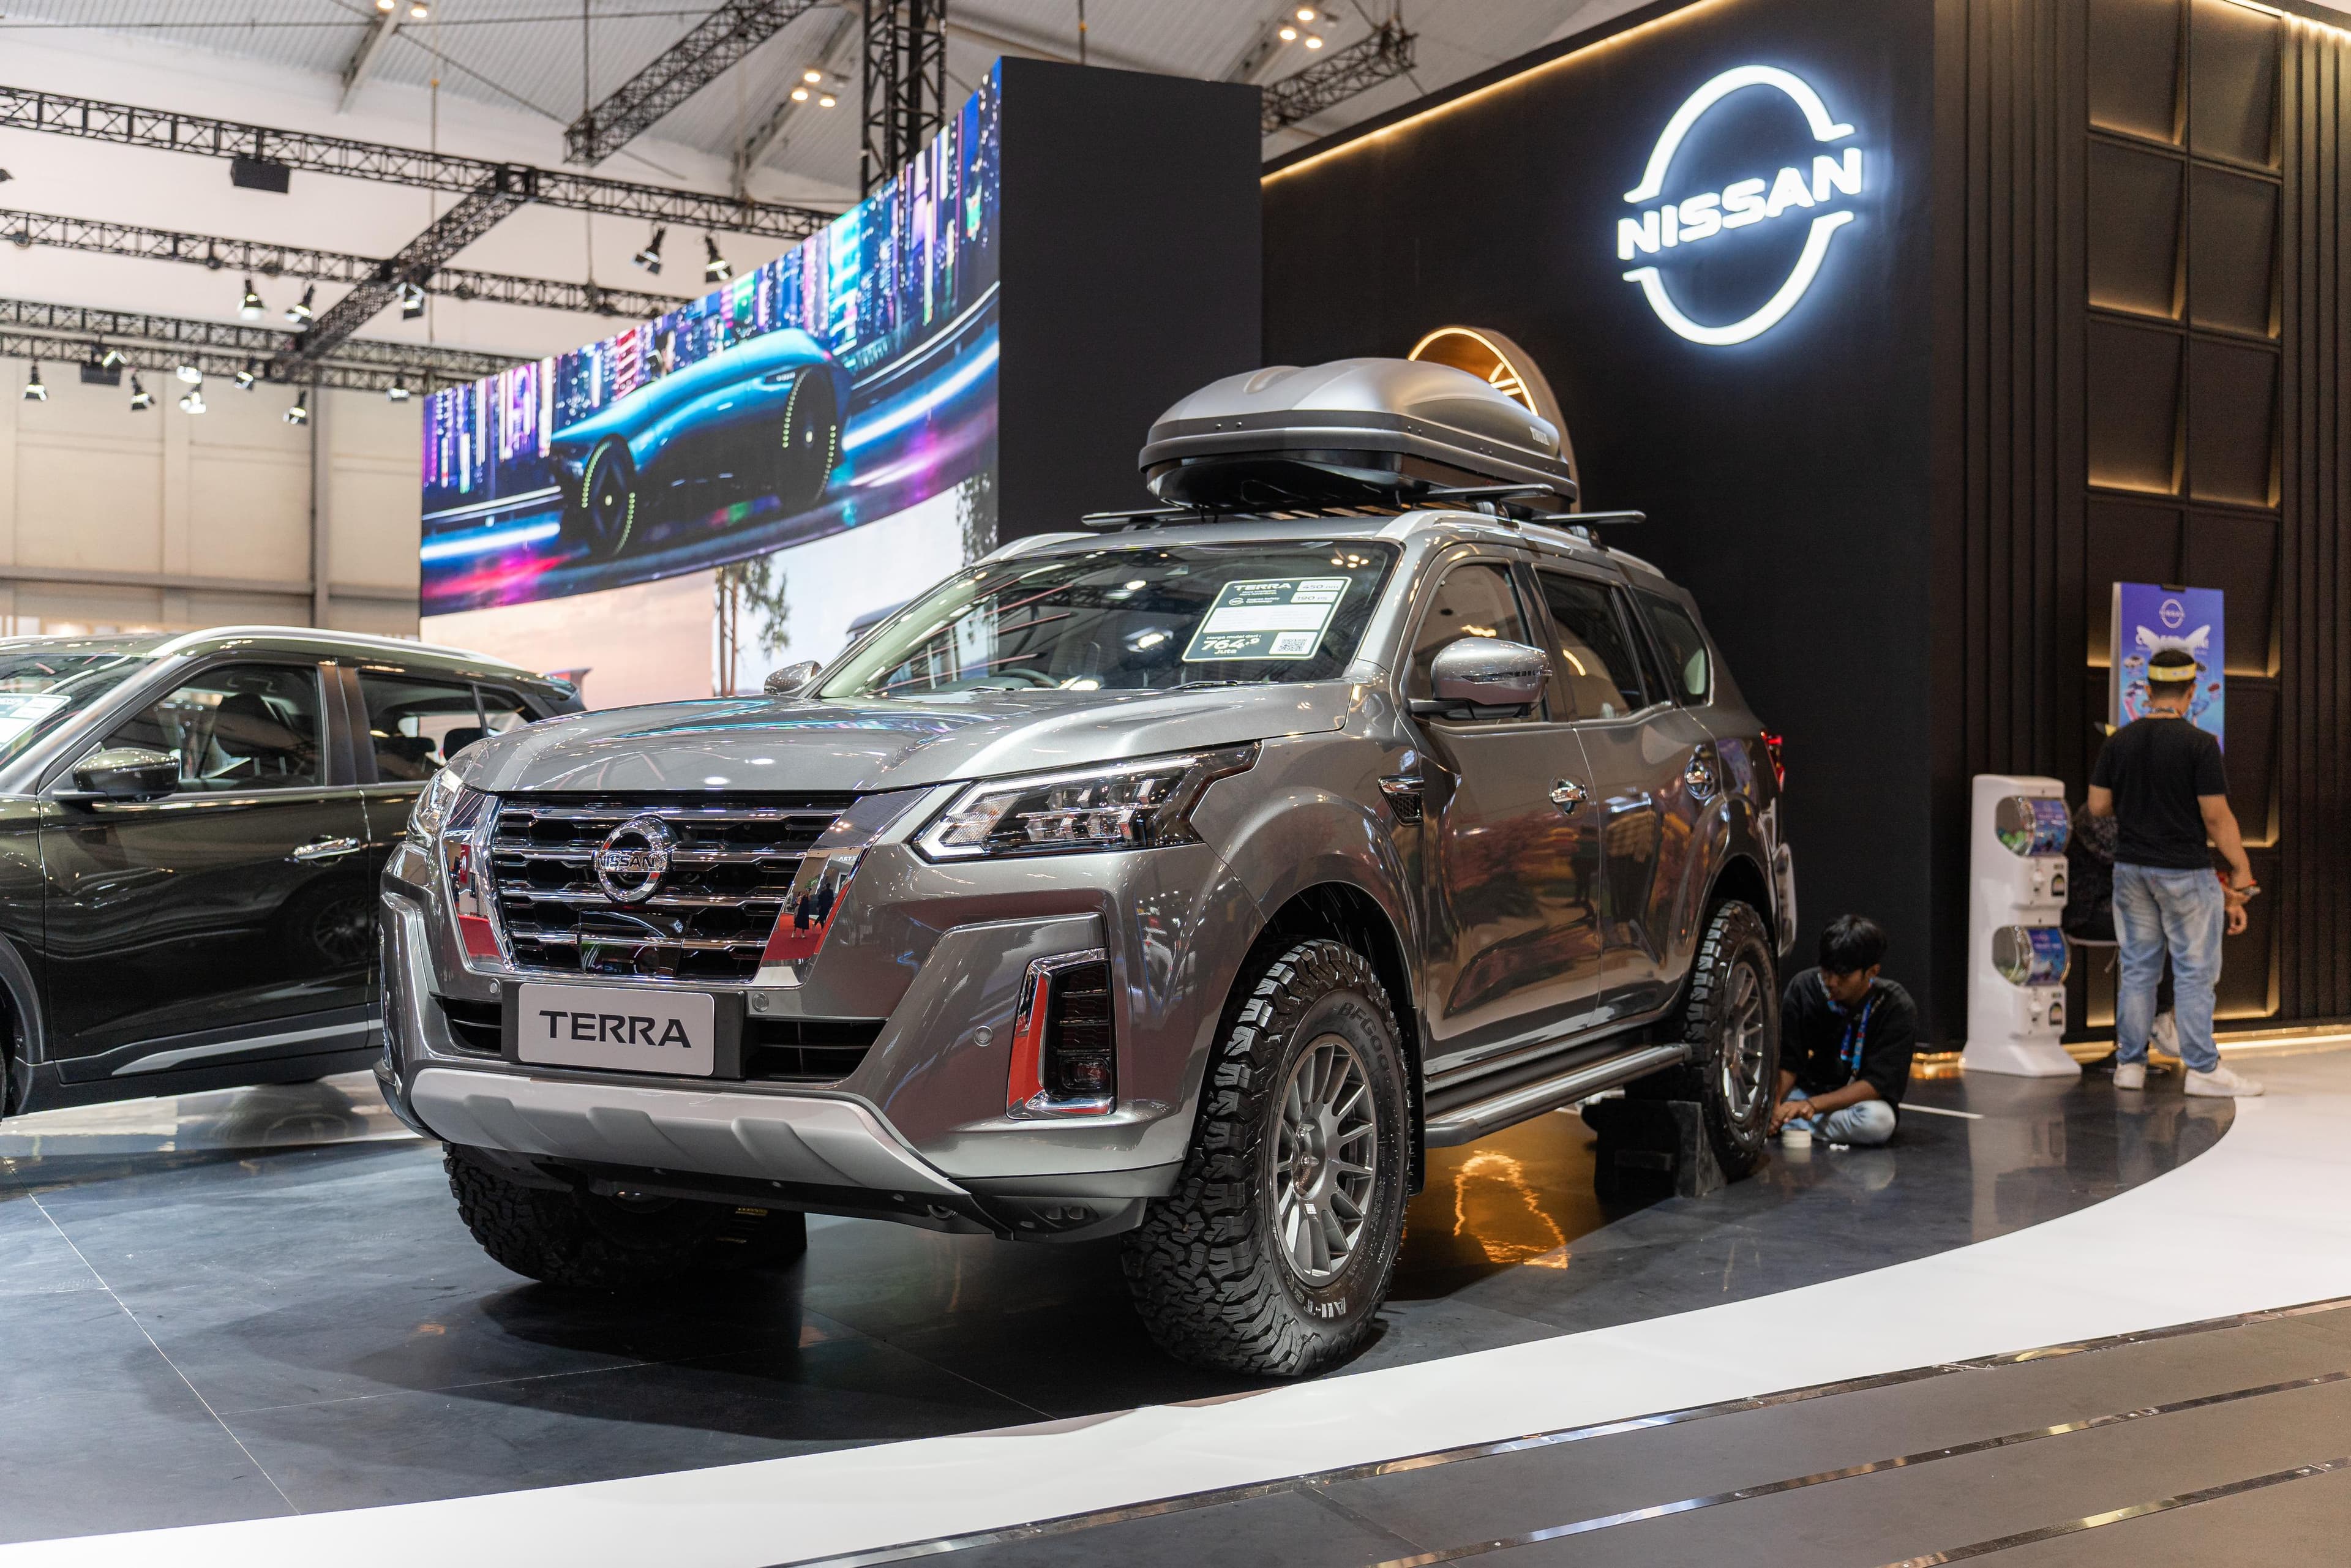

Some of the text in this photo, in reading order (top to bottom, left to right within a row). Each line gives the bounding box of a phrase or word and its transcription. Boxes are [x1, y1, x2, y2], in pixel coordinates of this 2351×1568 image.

[1617, 147, 1862, 261] NISSAN
[1234, 582, 1291, 591] TERRA
[598, 853, 656, 869] NISSAN
[538, 1010, 692, 1049] TERRA
